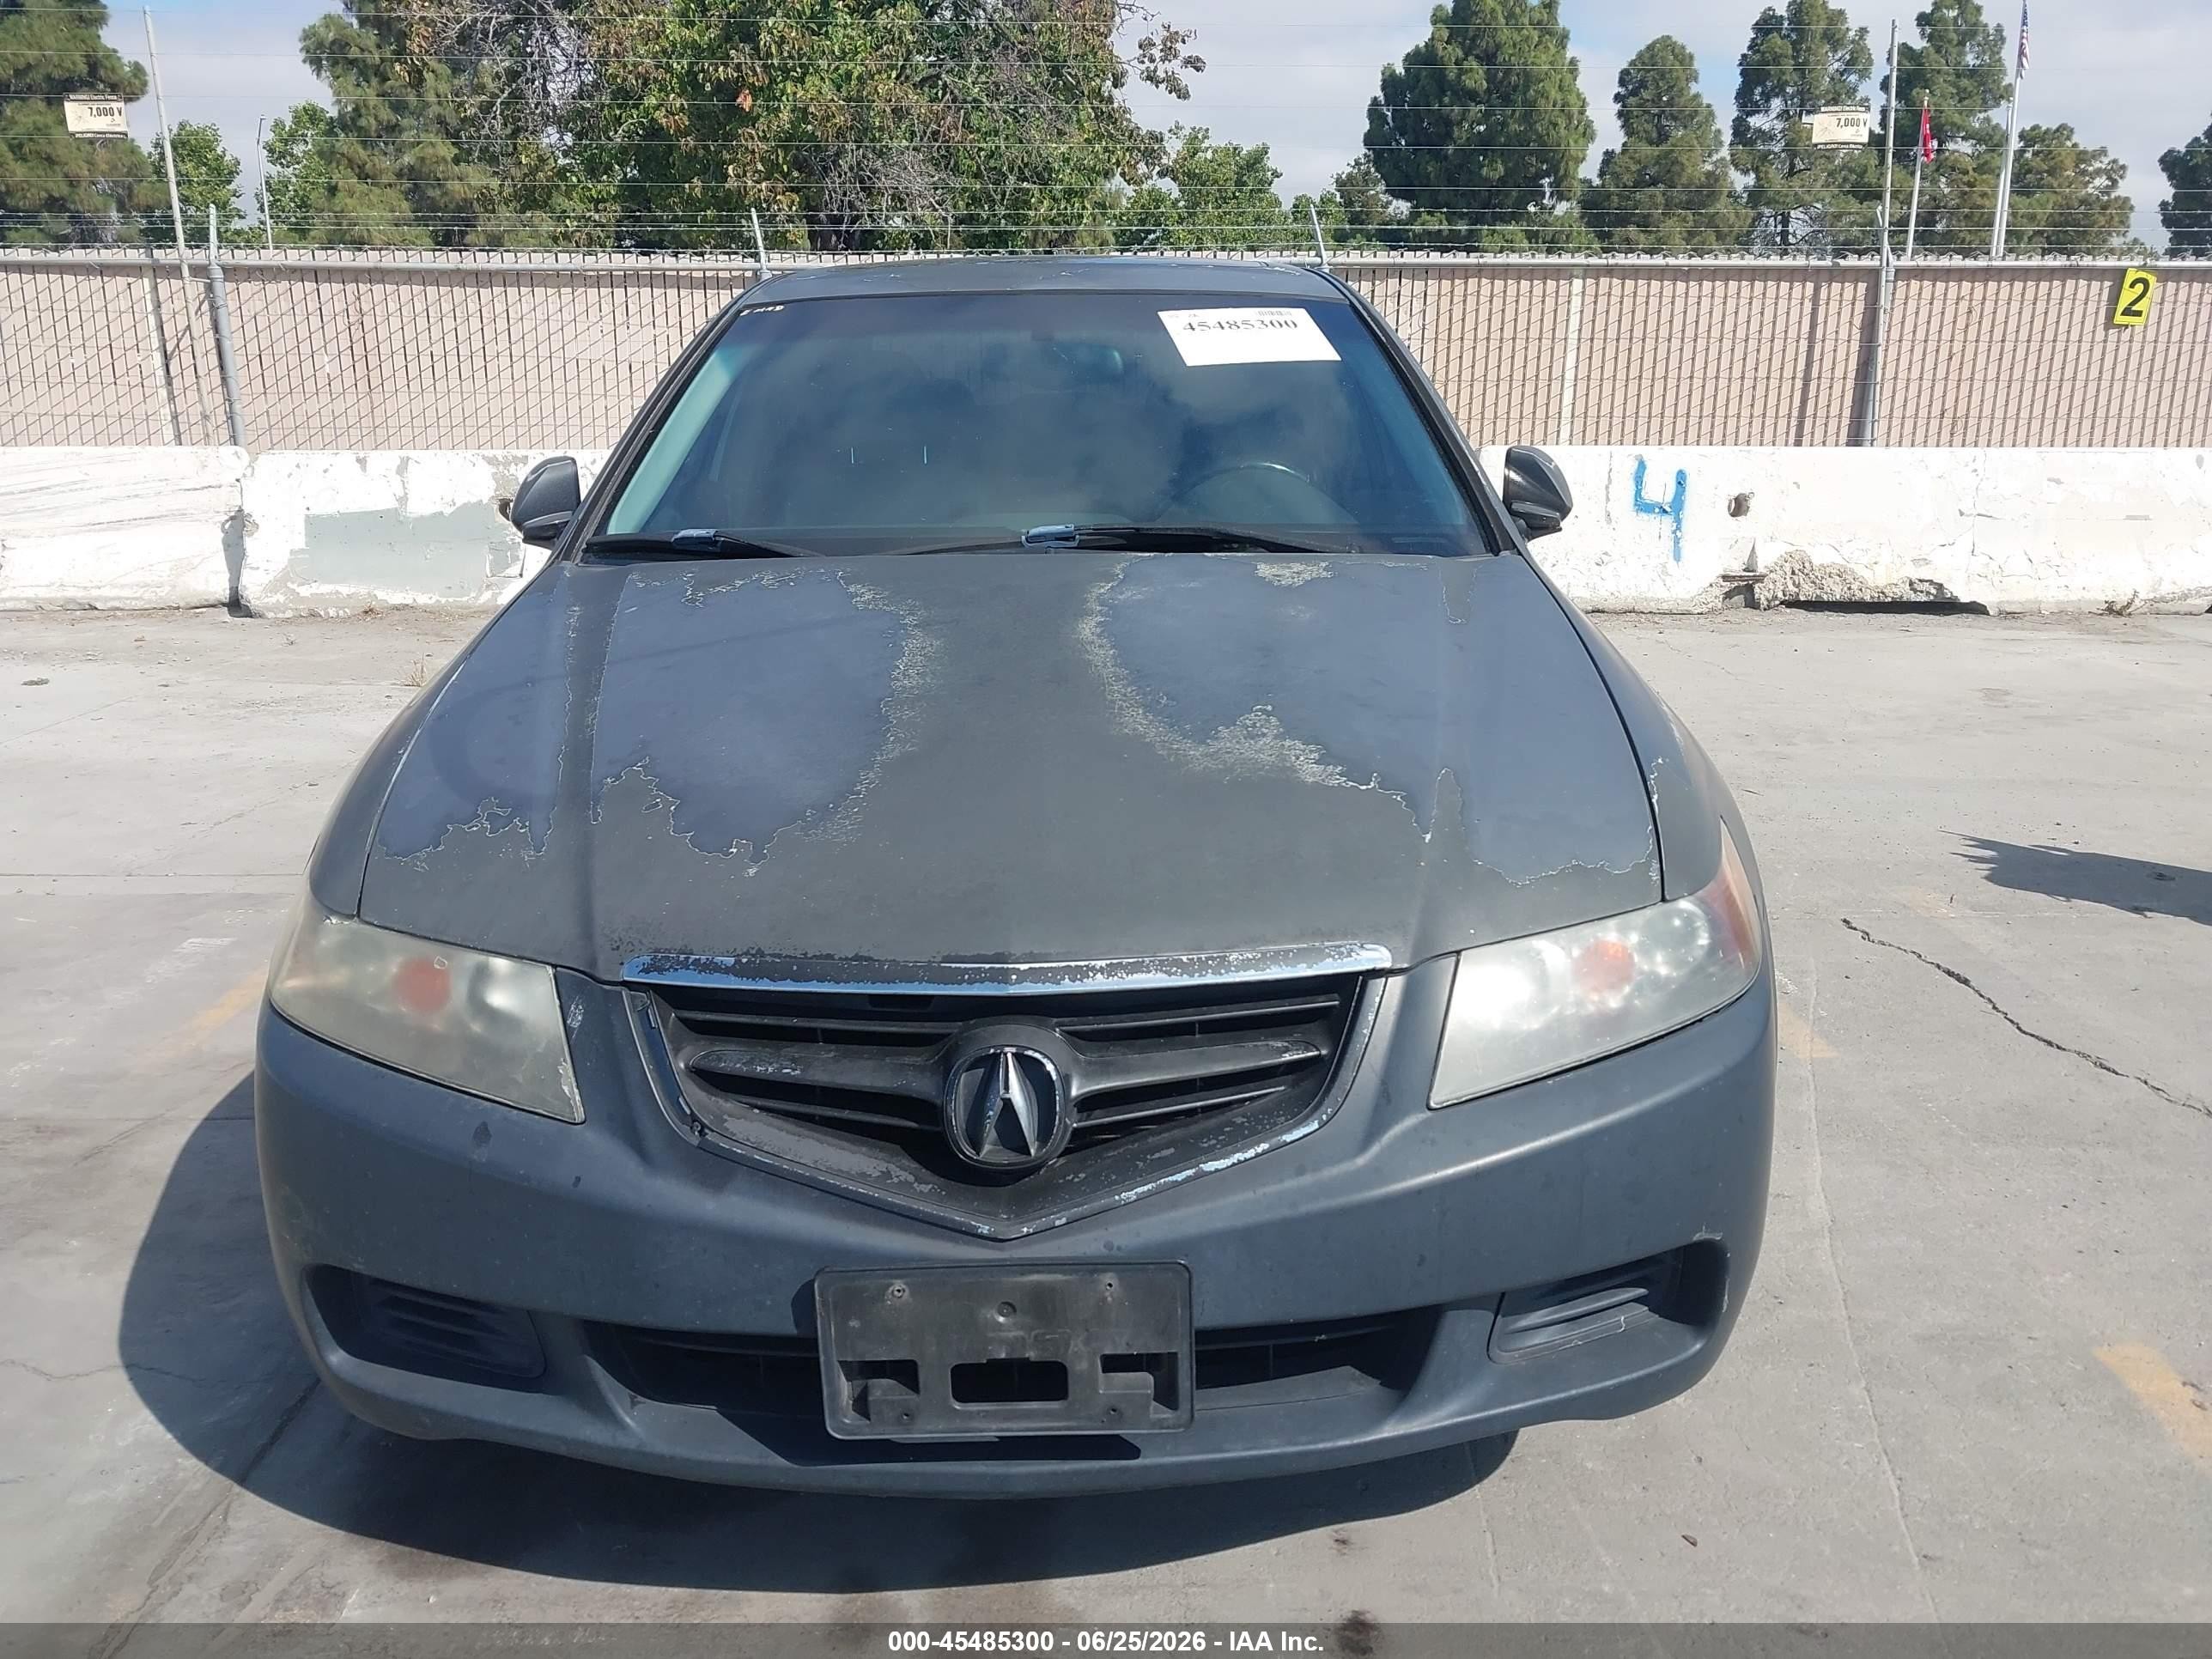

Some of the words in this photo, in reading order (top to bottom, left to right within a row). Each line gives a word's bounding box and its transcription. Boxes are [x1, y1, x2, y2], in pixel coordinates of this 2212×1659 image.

[88, 106, 115, 118] 7,000
[117, 106, 122, 117] V
[1836, 118, 1861, 129] 7,000
[1863, 118, 1868, 127] V
[2119, 276, 2150, 318] 2
[1182, 319, 1298, 332] 45485300
[1634, 454, 1687, 562] 4
